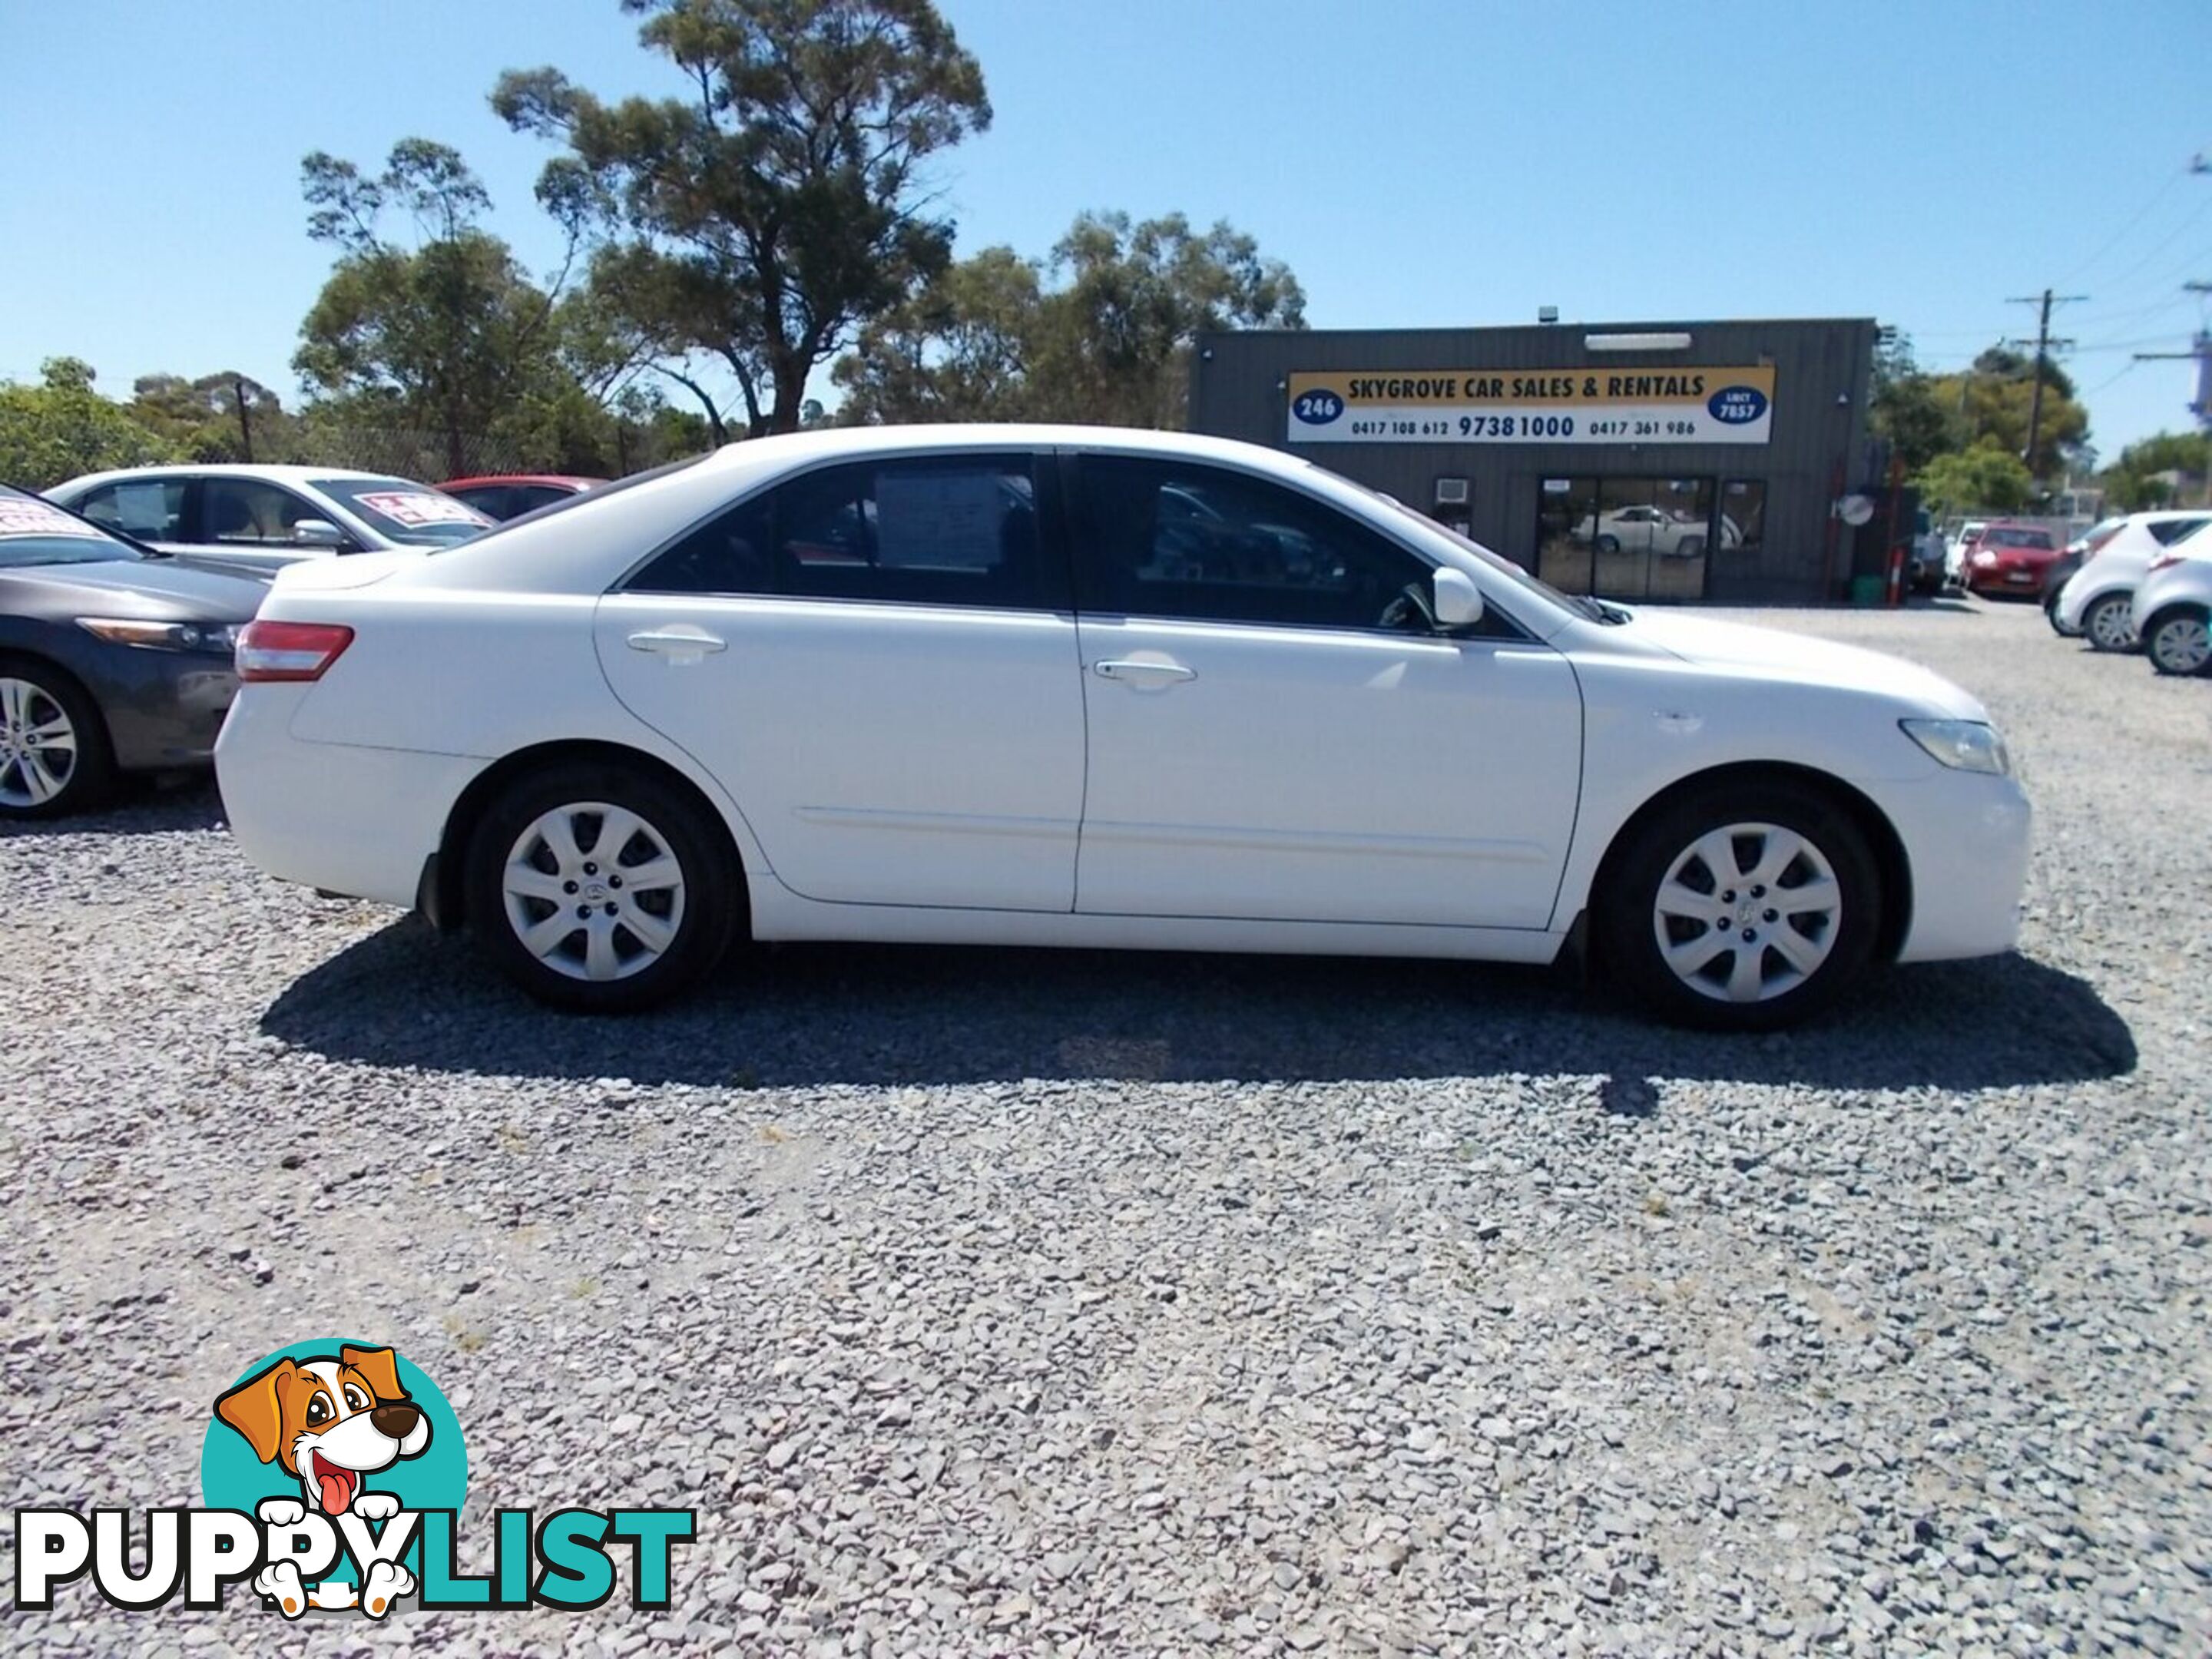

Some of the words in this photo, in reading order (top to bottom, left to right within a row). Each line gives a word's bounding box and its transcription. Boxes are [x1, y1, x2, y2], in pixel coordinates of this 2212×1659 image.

[1348, 378, 1456, 399] SKYGROVE
[1464, 377, 1504, 398] CAR
[1511, 377, 1574, 398] SALES
[1582, 376, 1598, 397] &
[1608, 376, 1704, 396] RENTALS
[1300, 398, 1336, 416] 246
[1352, 422, 1386, 435] 0417
[1392, 422, 1416, 435] 108
[1422, 422, 1449, 435] 612
[1589, 422, 1628, 435] 0417
[1634, 422, 1660, 435] 361
[1667, 422, 1696, 435] 986
